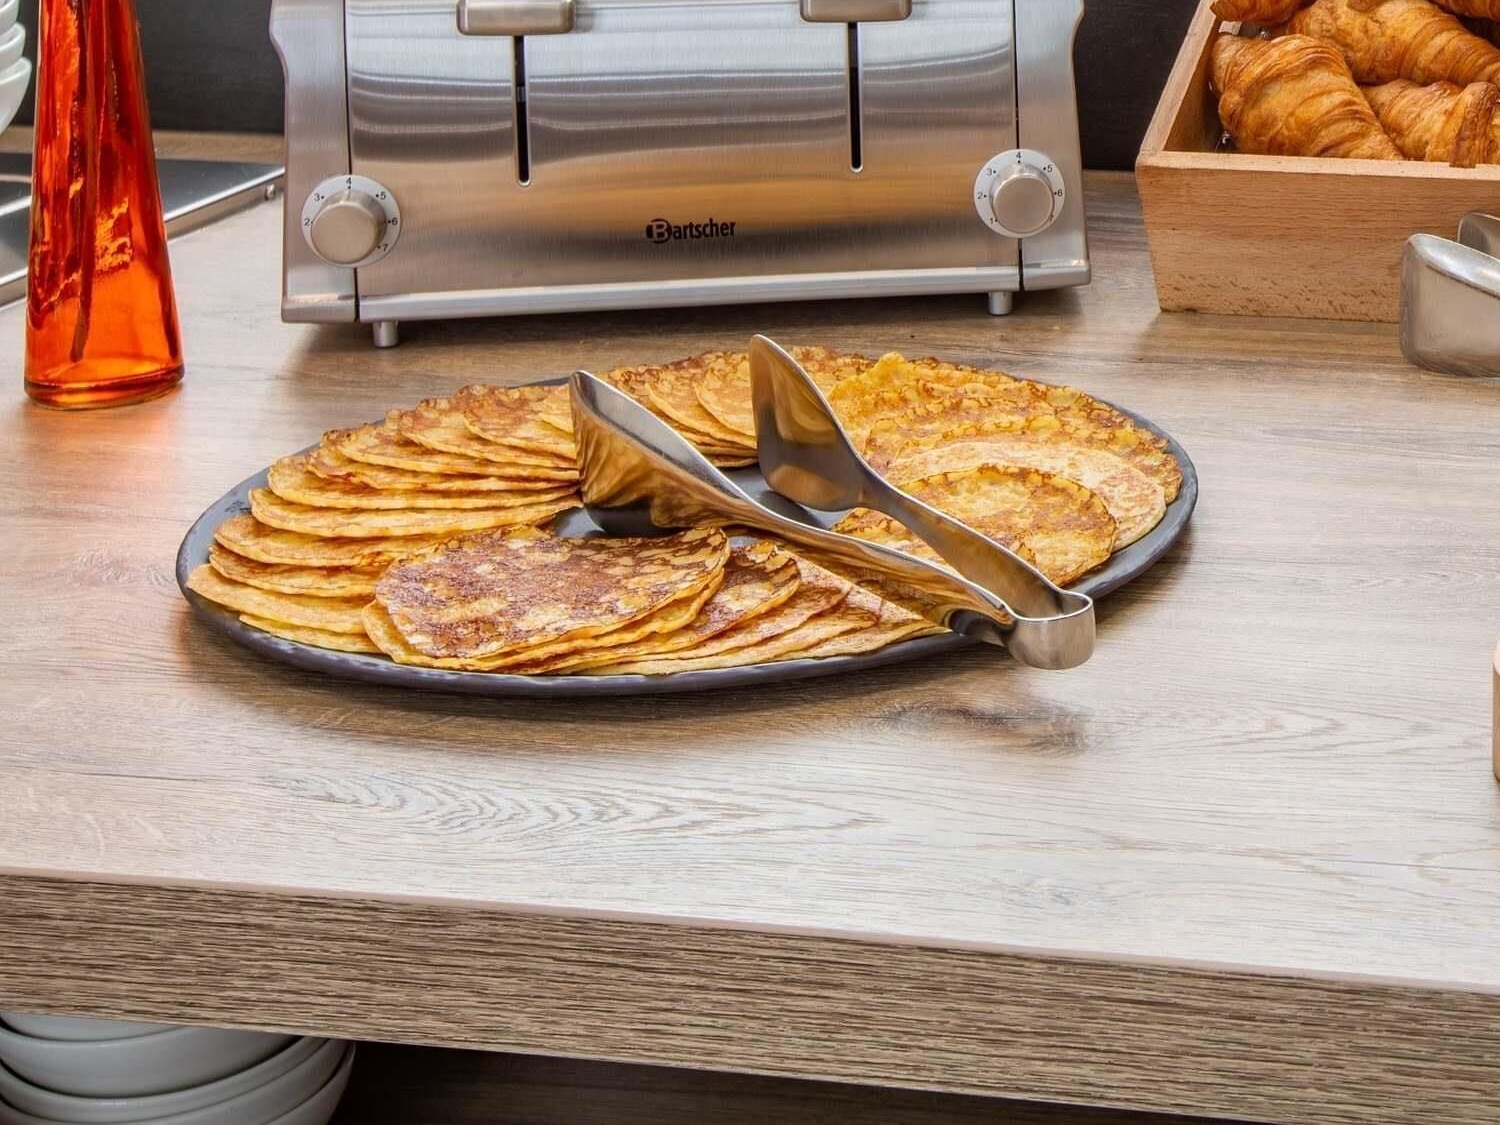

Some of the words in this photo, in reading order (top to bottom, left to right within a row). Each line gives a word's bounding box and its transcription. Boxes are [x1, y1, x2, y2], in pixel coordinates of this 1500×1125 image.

[1047, 164, 1053, 172] 5
[346, 177, 352, 185] 4
[380, 192, 386, 200] 5
[1057, 189, 1063, 197] 6
[304, 218, 310, 226] 2
[646, 217, 736, 244] Bartscher
